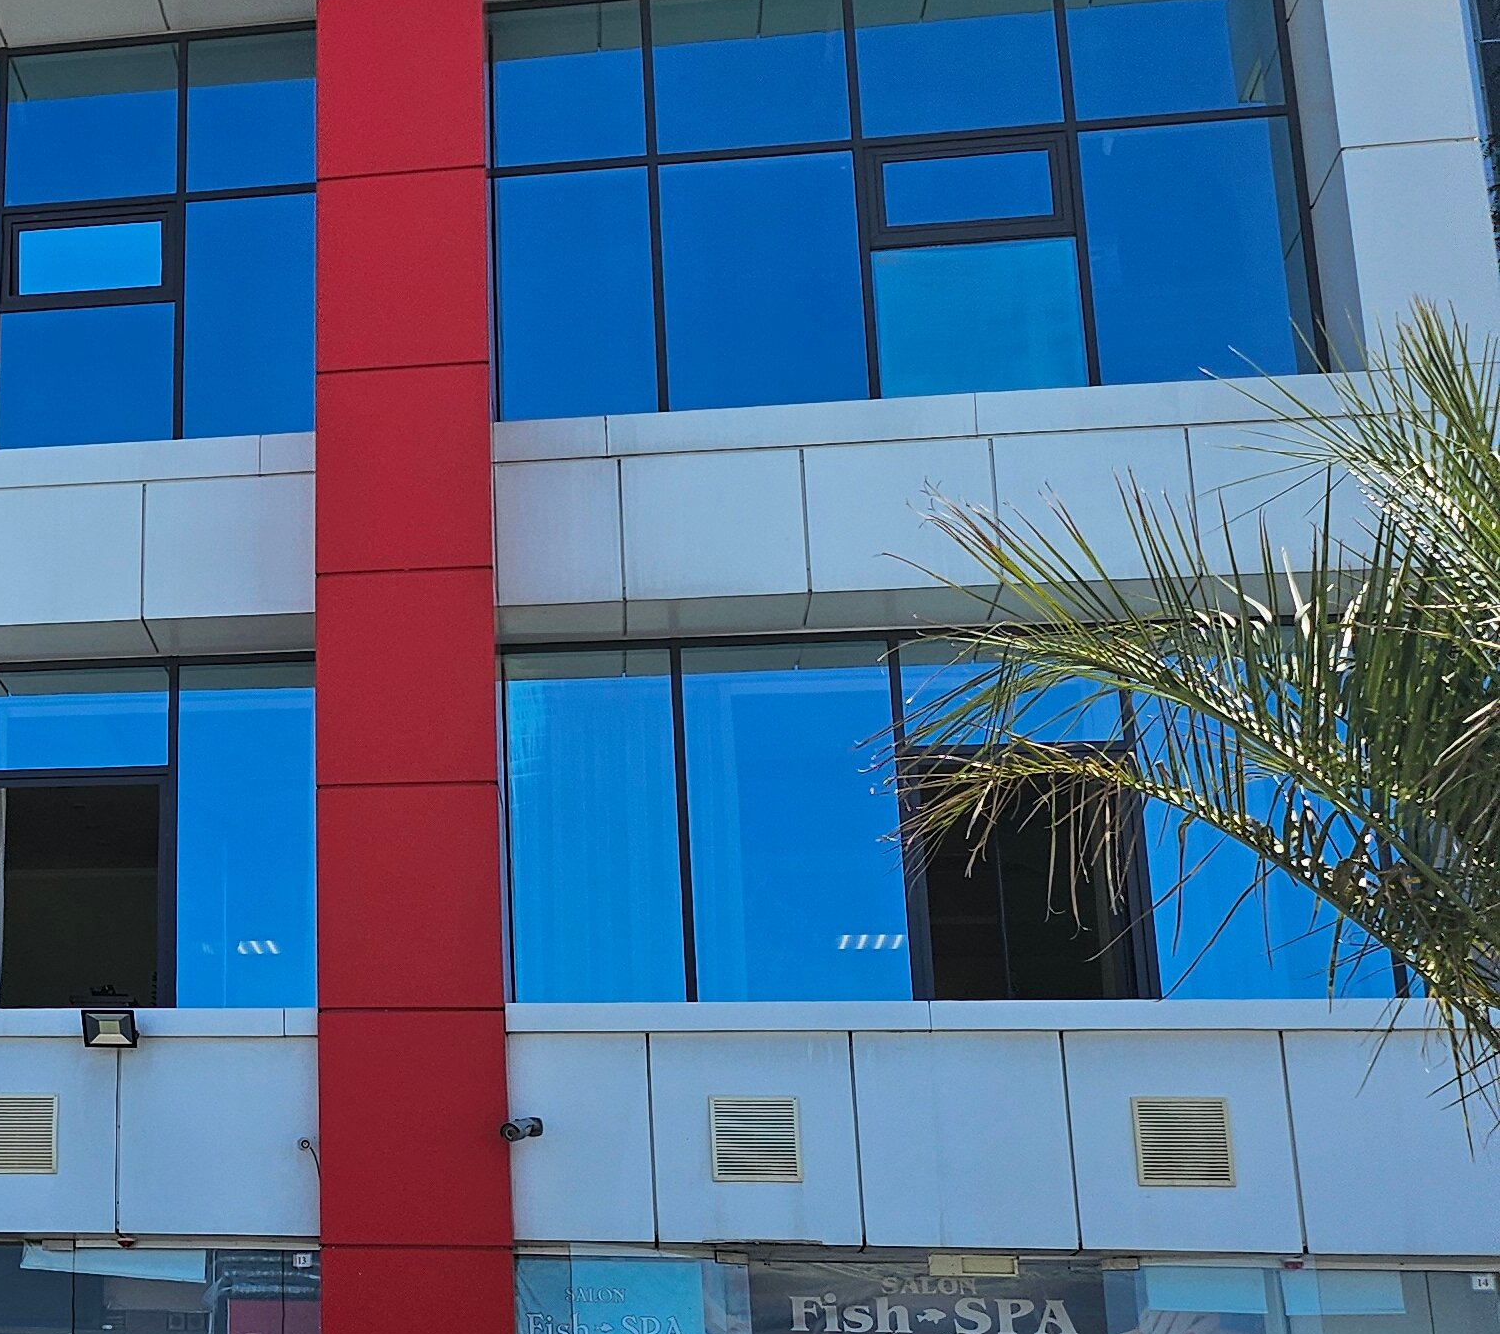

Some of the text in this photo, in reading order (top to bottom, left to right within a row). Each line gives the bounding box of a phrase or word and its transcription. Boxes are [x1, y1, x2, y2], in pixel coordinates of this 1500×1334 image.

[297, 1256, 307, 1265] 13
[881, 1276, 978, 1295] SALON
[565, 1286, 627, 1304] SALON
[788, 1292, 913, 1334] Fish
